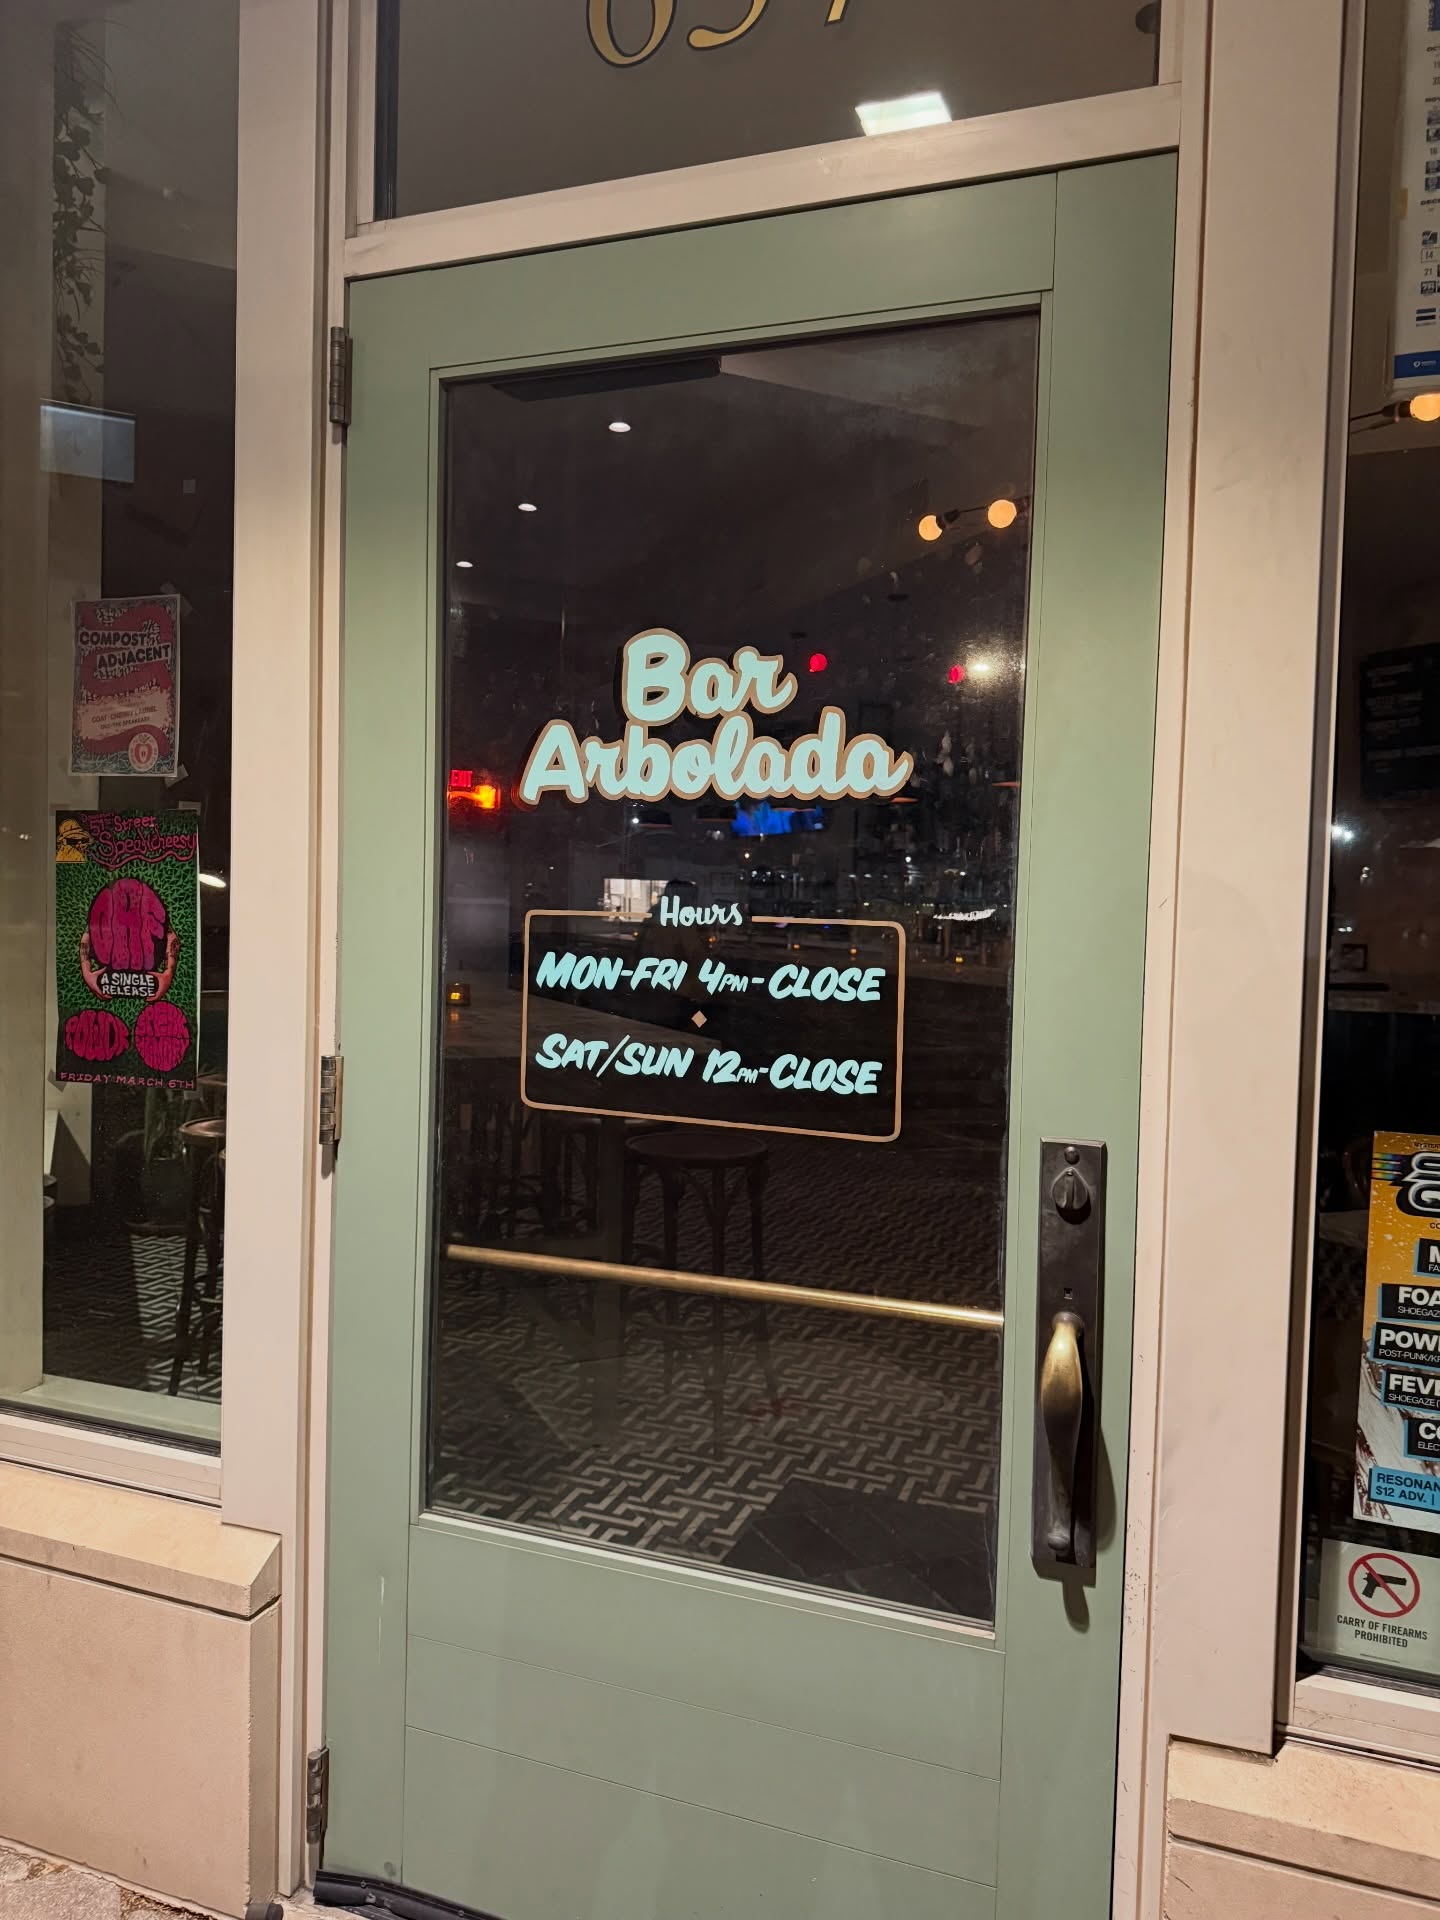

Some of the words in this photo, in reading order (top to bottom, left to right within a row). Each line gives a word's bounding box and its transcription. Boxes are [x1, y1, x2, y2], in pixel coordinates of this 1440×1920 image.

[79, 631, 147, 646] COMPOST
[98, 644, 171, 669] ADJACENT
[622, 628, 798, 727] Bar
[519, 706, 914, 804] Arbolada
[659, 895, 743, 928] Hours
[100, 973, 109, 985] A
[111, 972, 155, 987] SINGLE
[535, 951, 688, 991] MON-FRI
[102, 984, 155, 997] RELEASE
[535, 1033, 694, 1078] SAT/SUN
[60, 1072, 111, 1084] FRIDAY
[115, 1075, 163, 1087] MARCH
[168, 1079, 194, 1089] 6TH
[1397, 1305, 1440, 1318] SHOEGAZ
[1379, 1328, 1440, 1352] POW
[1375, 1485, 1395, 1498] $12
[1398, 1489, 1427, 1503] ADV.
[1336, 1614, 1366, 1628] CARRY
[1368, 1620, 1380, 1631] OF
[1382, 1623, 1428, 1640] FIREARMS
[1354, 1629, 1408, 1647] PROHIBITED
